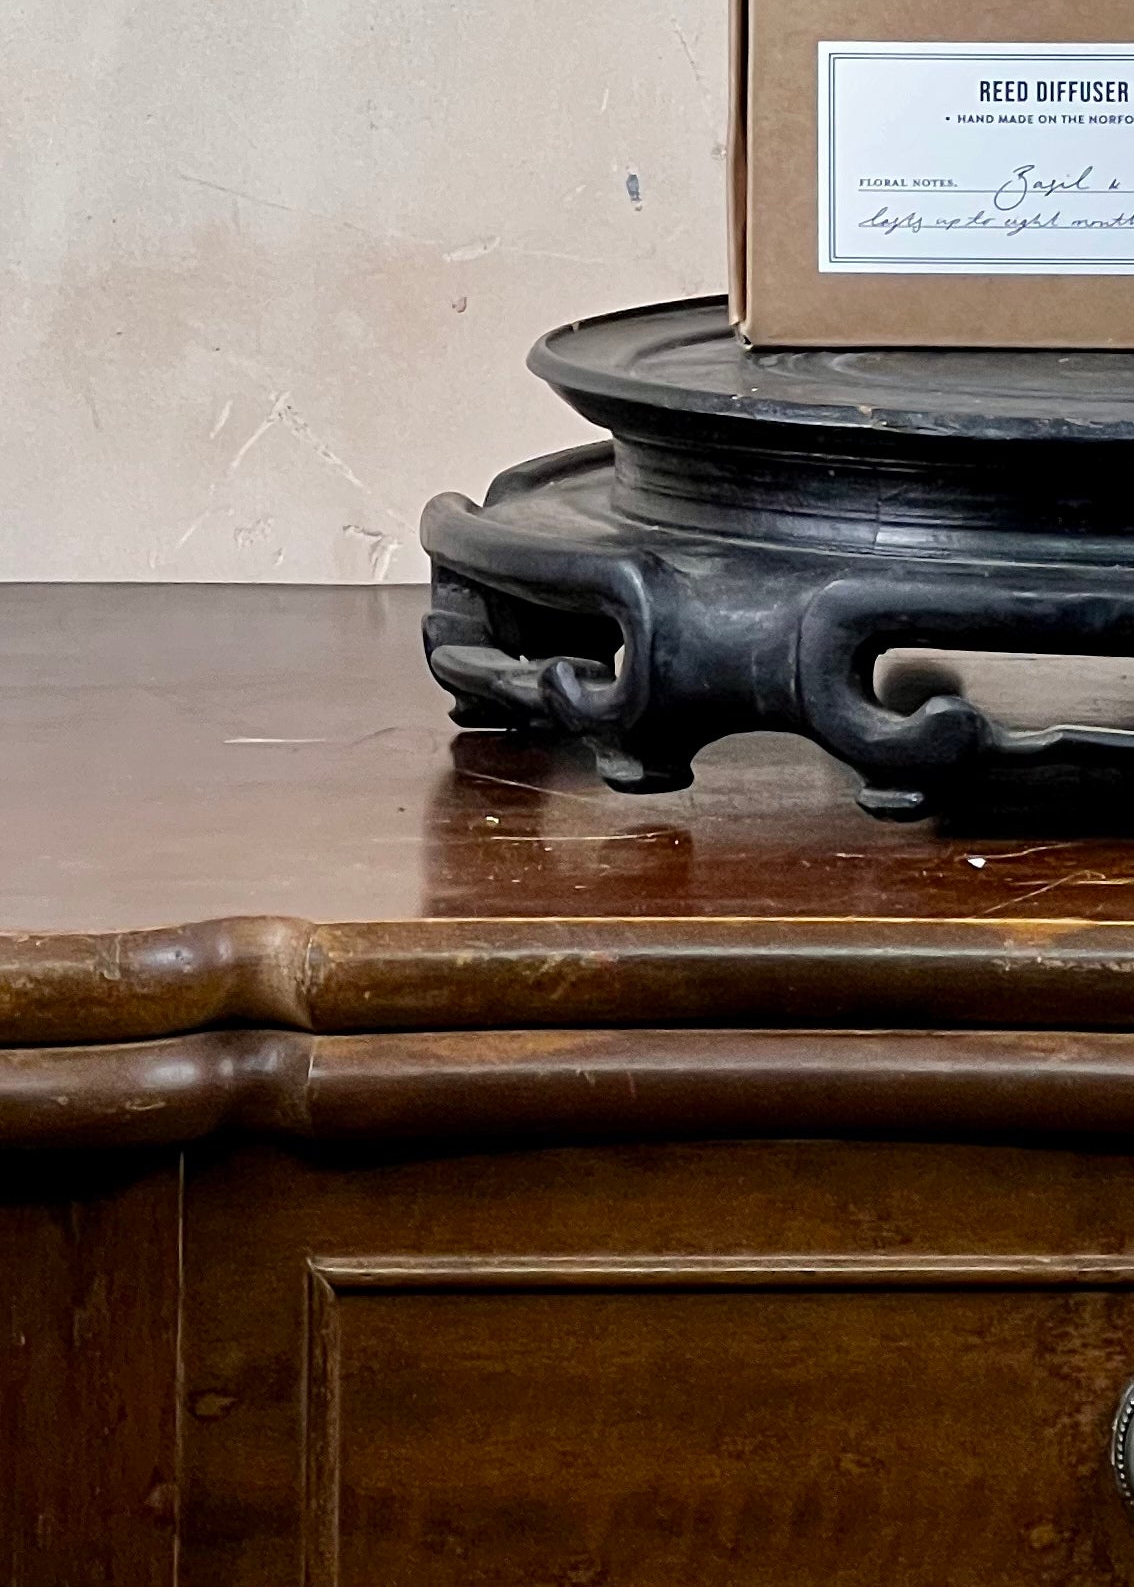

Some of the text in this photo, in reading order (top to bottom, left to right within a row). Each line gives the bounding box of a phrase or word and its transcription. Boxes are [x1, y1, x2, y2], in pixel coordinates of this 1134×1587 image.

[979, 80, 1028, 103] REED
[1036, 80, 1129, 103] DIFFUSER
[957, 114, 995, 125] HAND
[998, 114, 1035, 125] MADE
[1038, 114, 1059, 125] ON
[1061, 114, 1085, 125] THE
[858, 178, 908, 188] FLORAL
[912, 178, 958, 188] NOTES.
[994, 164, 1094, 211] Basil
[935, 216, 961, 231] up
[968, 210, 996, 227] to
